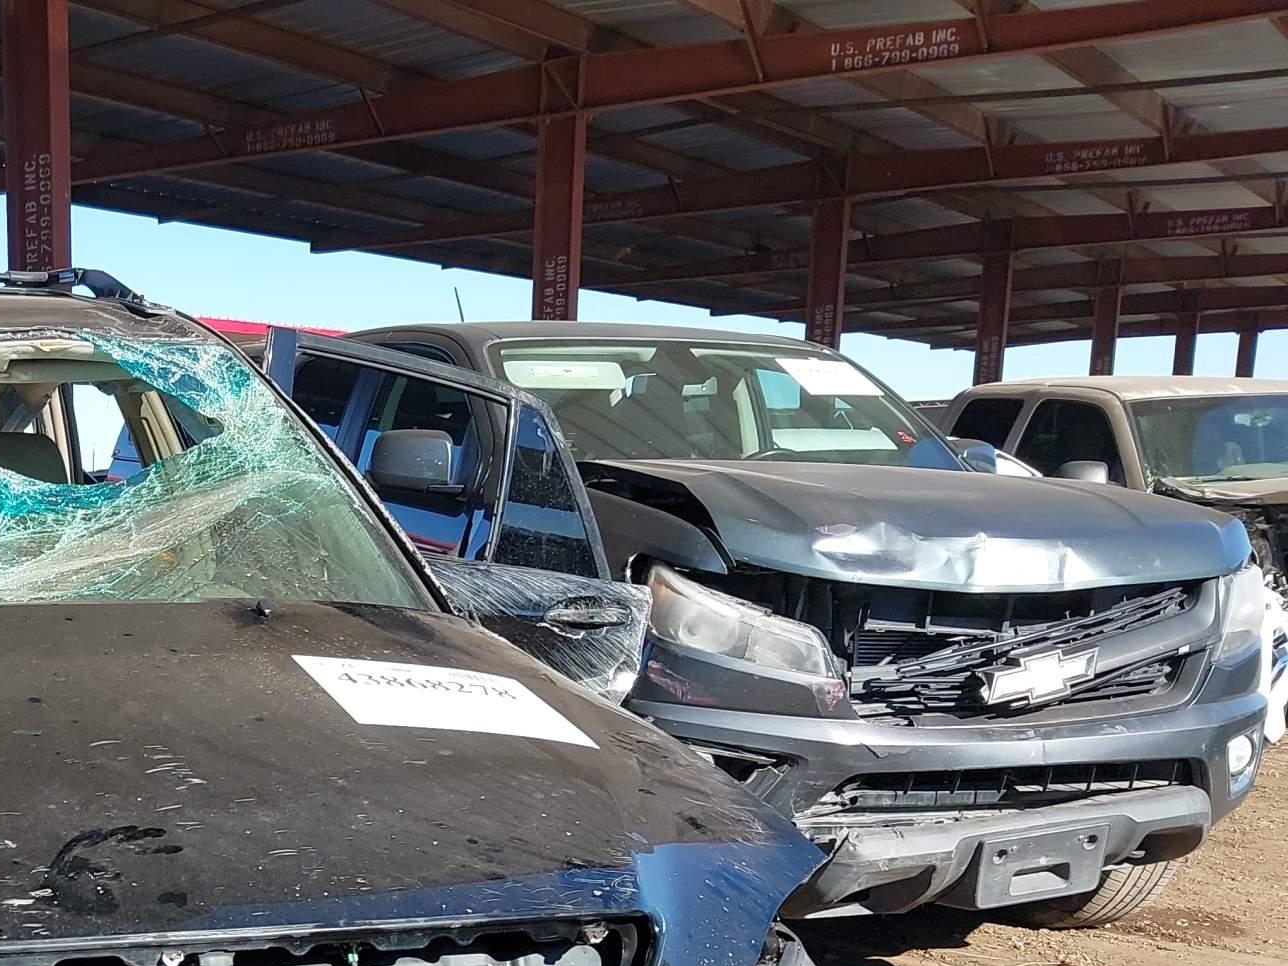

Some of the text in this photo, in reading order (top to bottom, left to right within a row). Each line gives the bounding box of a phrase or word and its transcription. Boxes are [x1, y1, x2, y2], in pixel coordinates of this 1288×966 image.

[831, 27, 961, 57] U.S. PREFAB INC.
[23, 152, 37, 192] INC.
[544, 254, 557, 281] INC.
